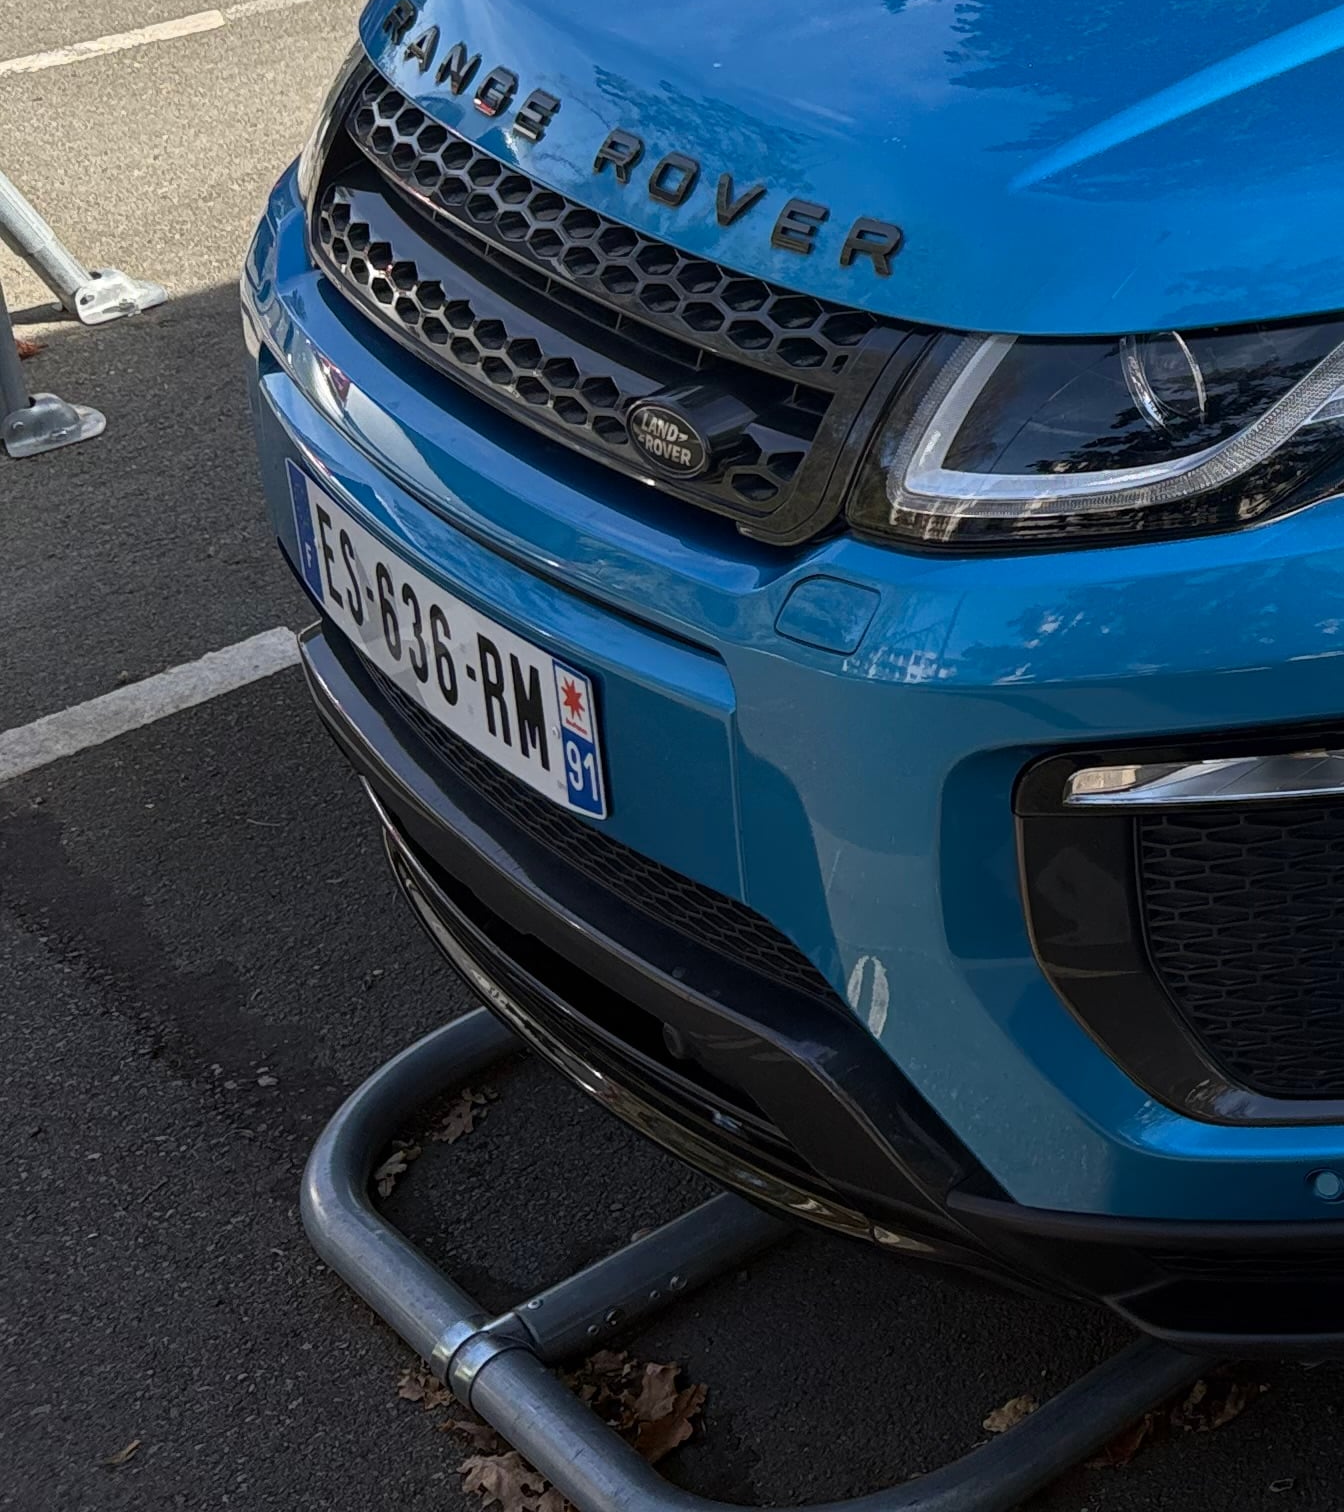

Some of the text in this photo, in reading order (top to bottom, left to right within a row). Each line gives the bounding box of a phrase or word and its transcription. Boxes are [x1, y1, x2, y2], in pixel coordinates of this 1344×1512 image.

[593, 126, 904, 277] ROVER
[641, 412, 680, 442] LAND
[644, 433, 692, 467] ROVER
[304, 542, 314, 568] F
[316, 503, 550, 772] ES-636-RM
[566, 740, 599, 802] 91
